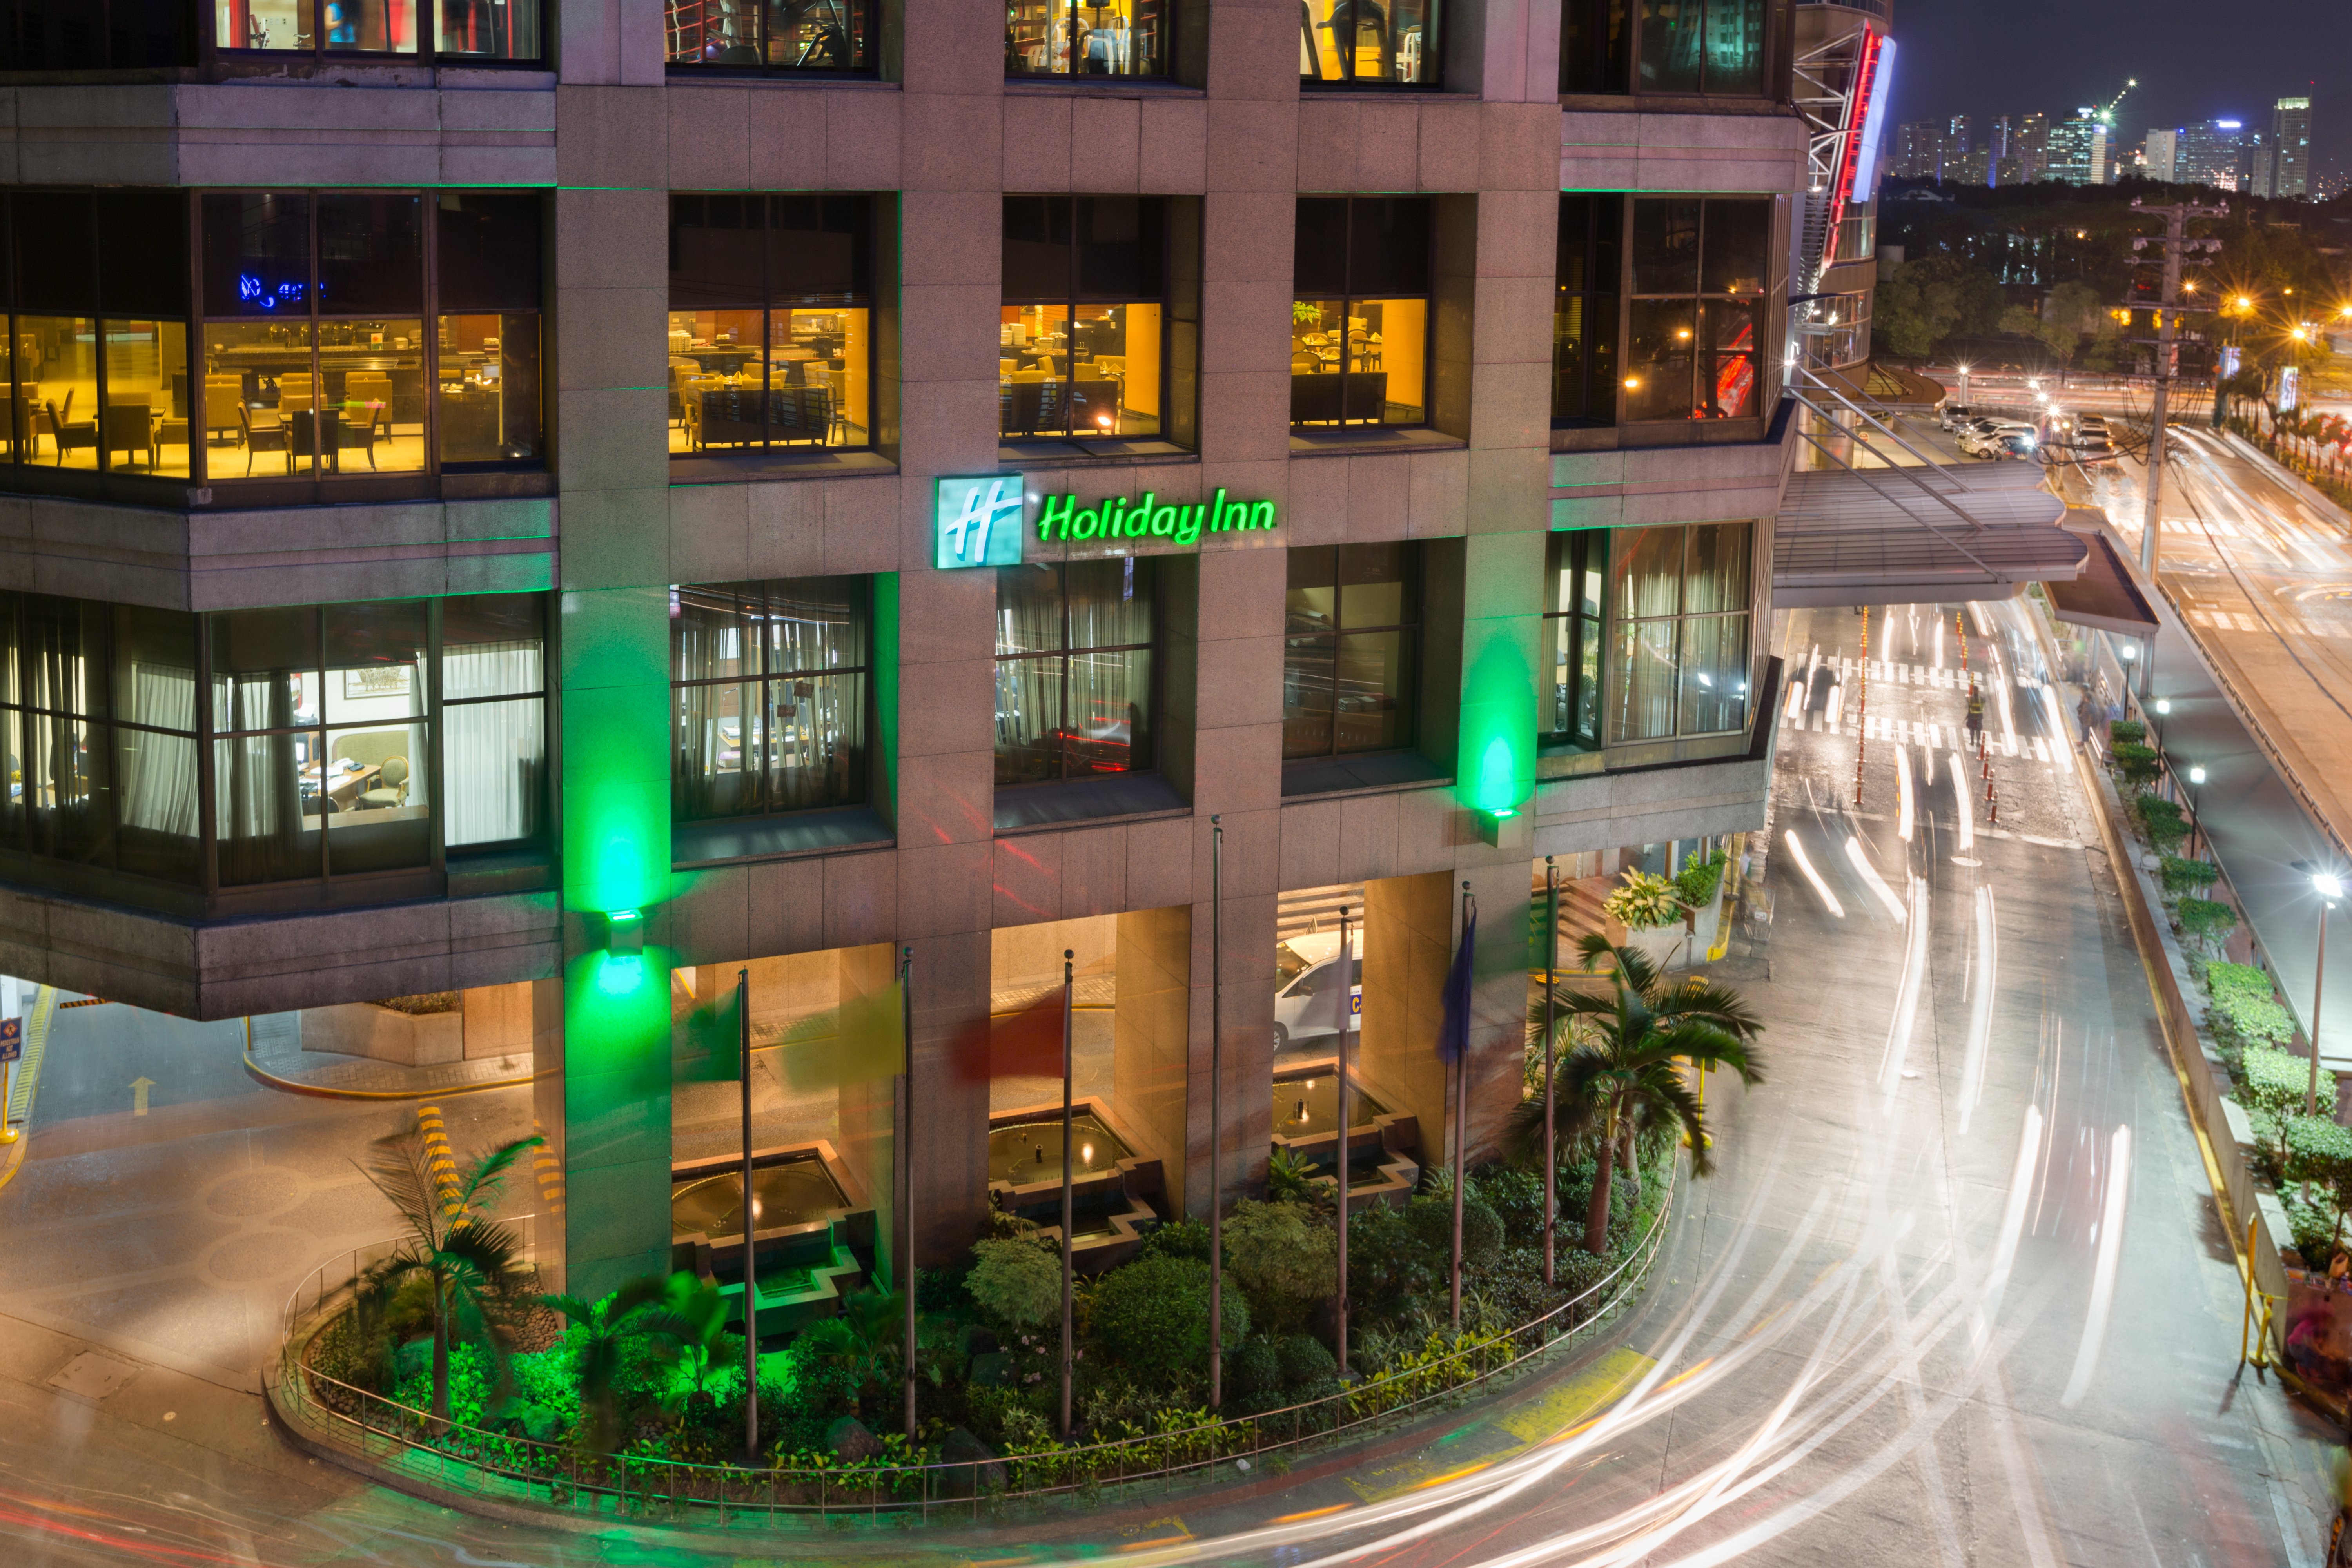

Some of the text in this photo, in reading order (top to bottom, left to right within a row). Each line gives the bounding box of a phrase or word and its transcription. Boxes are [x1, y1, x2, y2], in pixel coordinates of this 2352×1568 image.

[1038, 488, 1275, 545] Holiday Inn
[0, 1037, 20, 1047] PEDESTRIAN
[2, 1051, 17, 1060] ALLOWED
